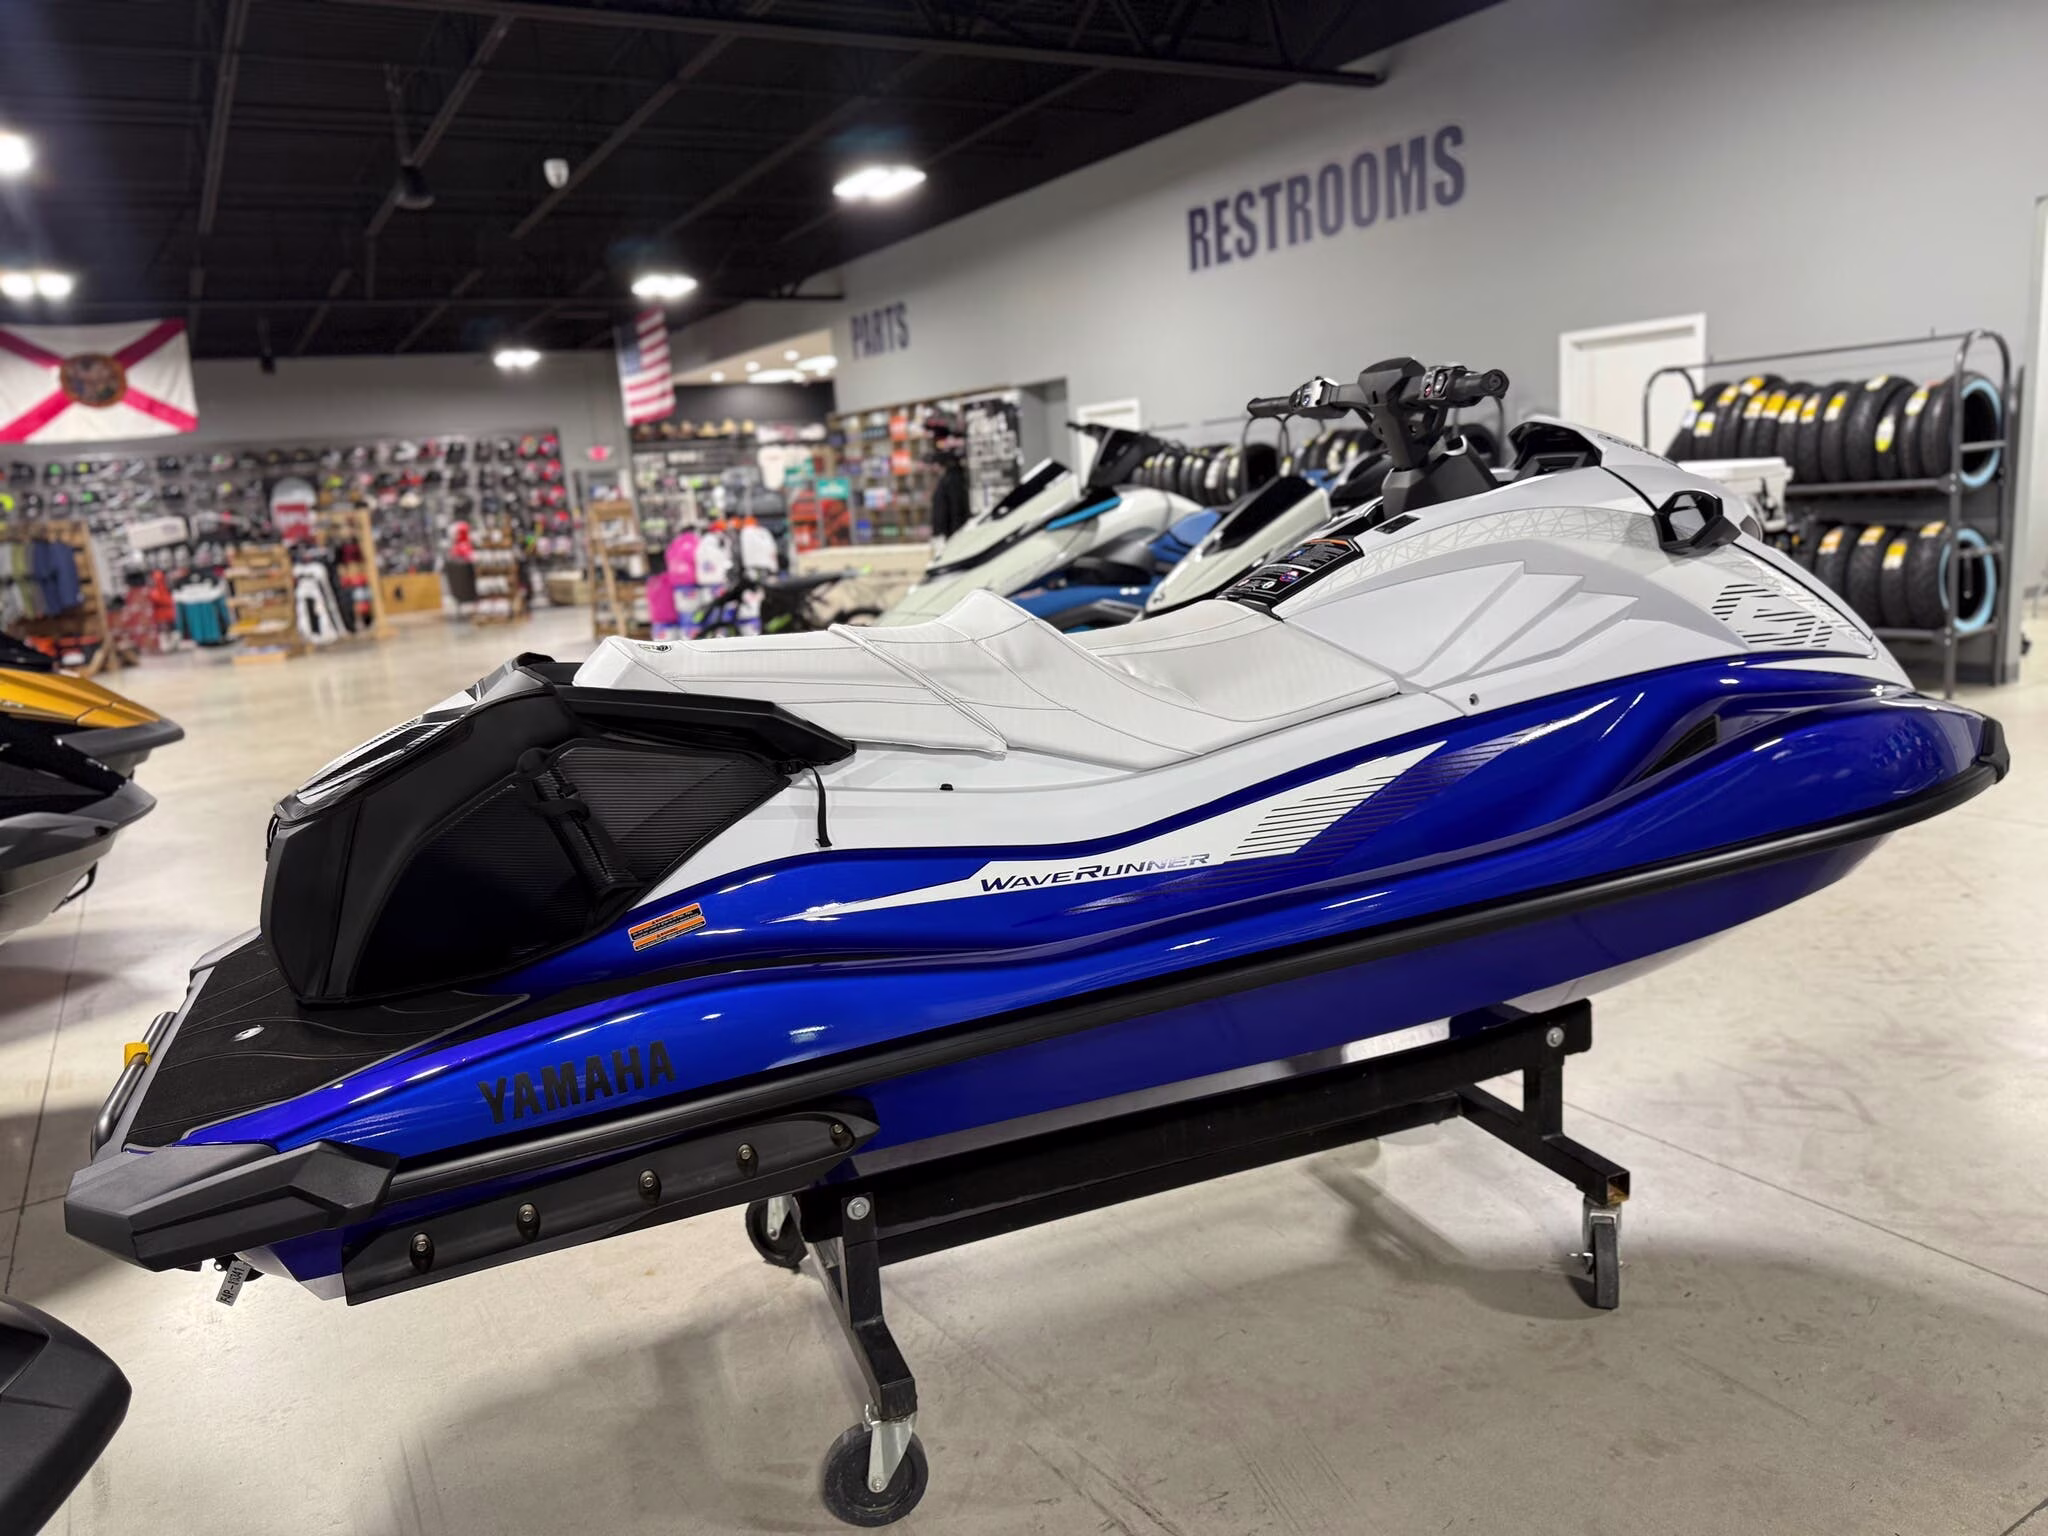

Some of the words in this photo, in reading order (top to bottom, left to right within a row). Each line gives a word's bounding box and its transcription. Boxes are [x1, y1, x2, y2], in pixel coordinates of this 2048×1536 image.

[1187, 124, 1466, 272] RESTROOMS
[851, 301, 909, 360] PARTS
[476, 1039, 677, 1125] YAMAHA
